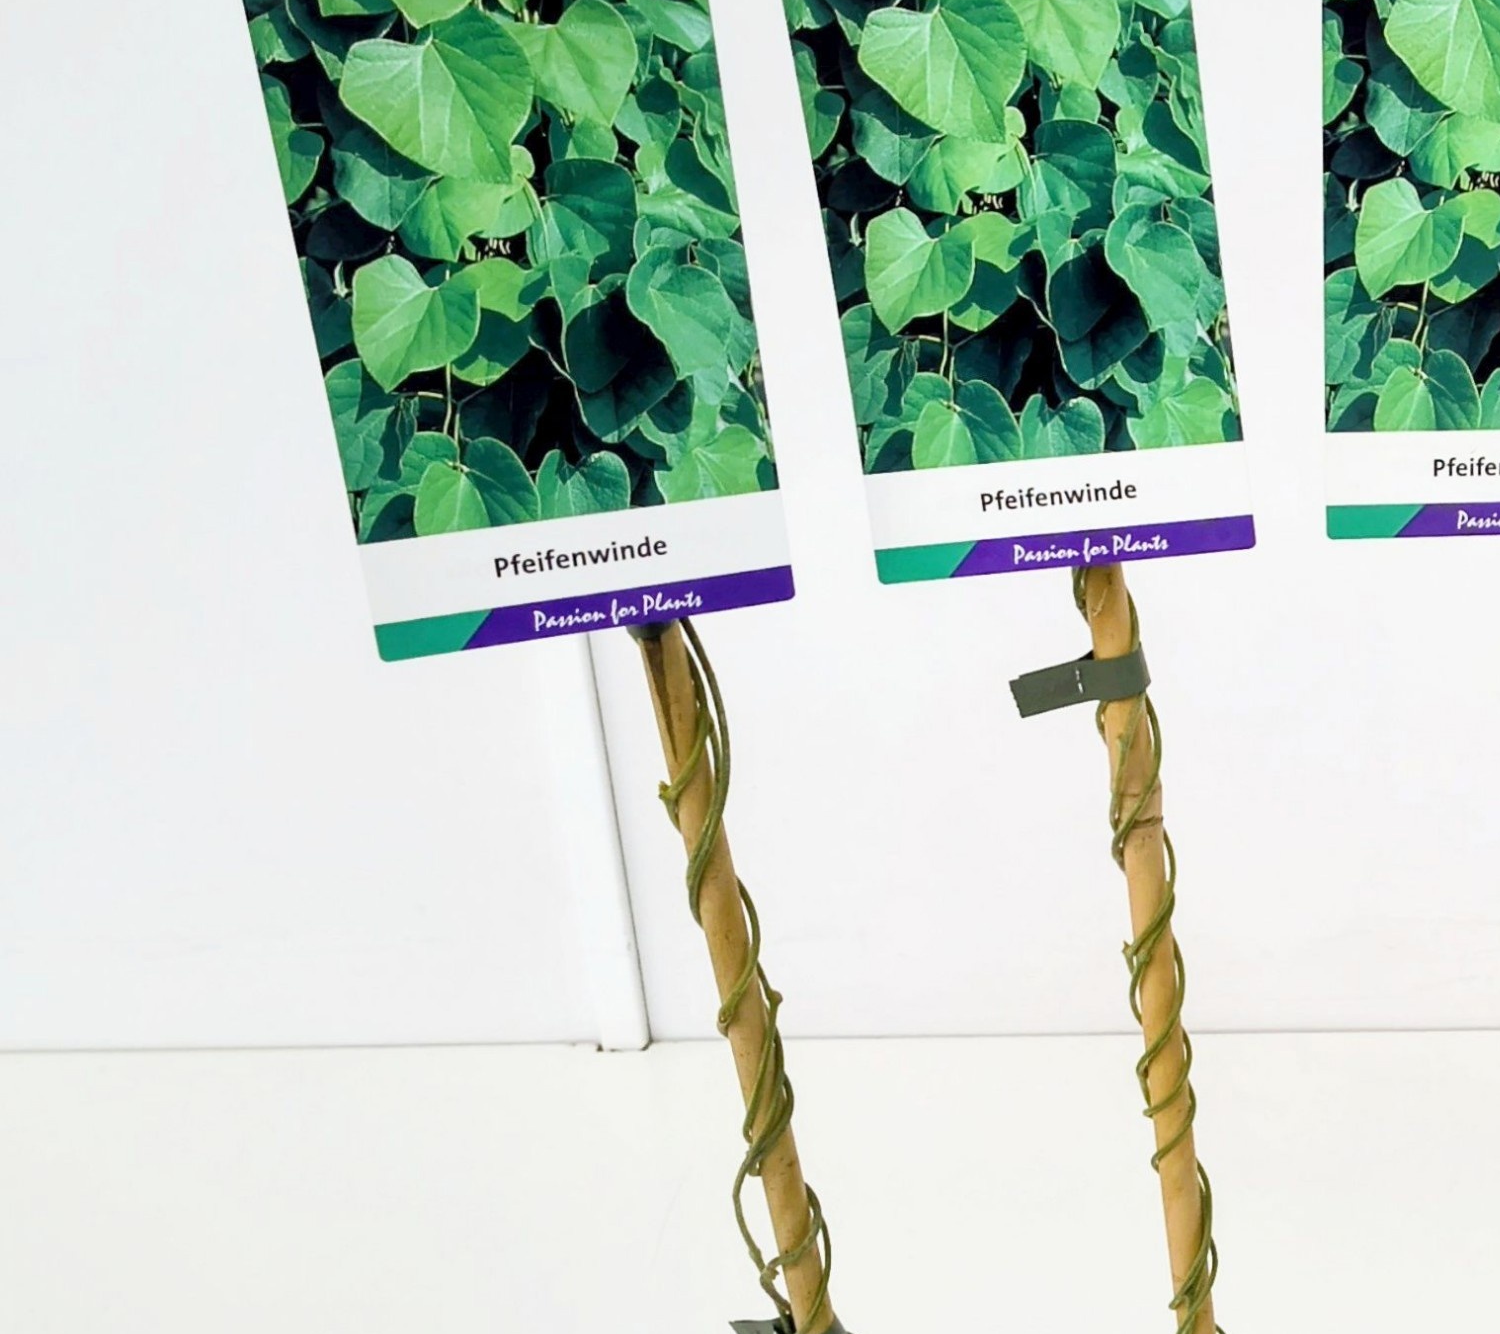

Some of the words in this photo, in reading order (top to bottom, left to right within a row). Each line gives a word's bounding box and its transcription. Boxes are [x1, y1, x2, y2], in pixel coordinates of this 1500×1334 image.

[980, 479, 1137, 512] Pfeifenwinde
[494, 536, 668, 578] Pfeifenwinde
[1013, 544, 1080, 565] Passion
[1082, 537, 1109, 563] for
[1112, 533, 1169, 556] Plants
[533, 610, 606, 632] Passion
[610, 598, 639, 625] for
[642, 591, 702, 616] Plants
